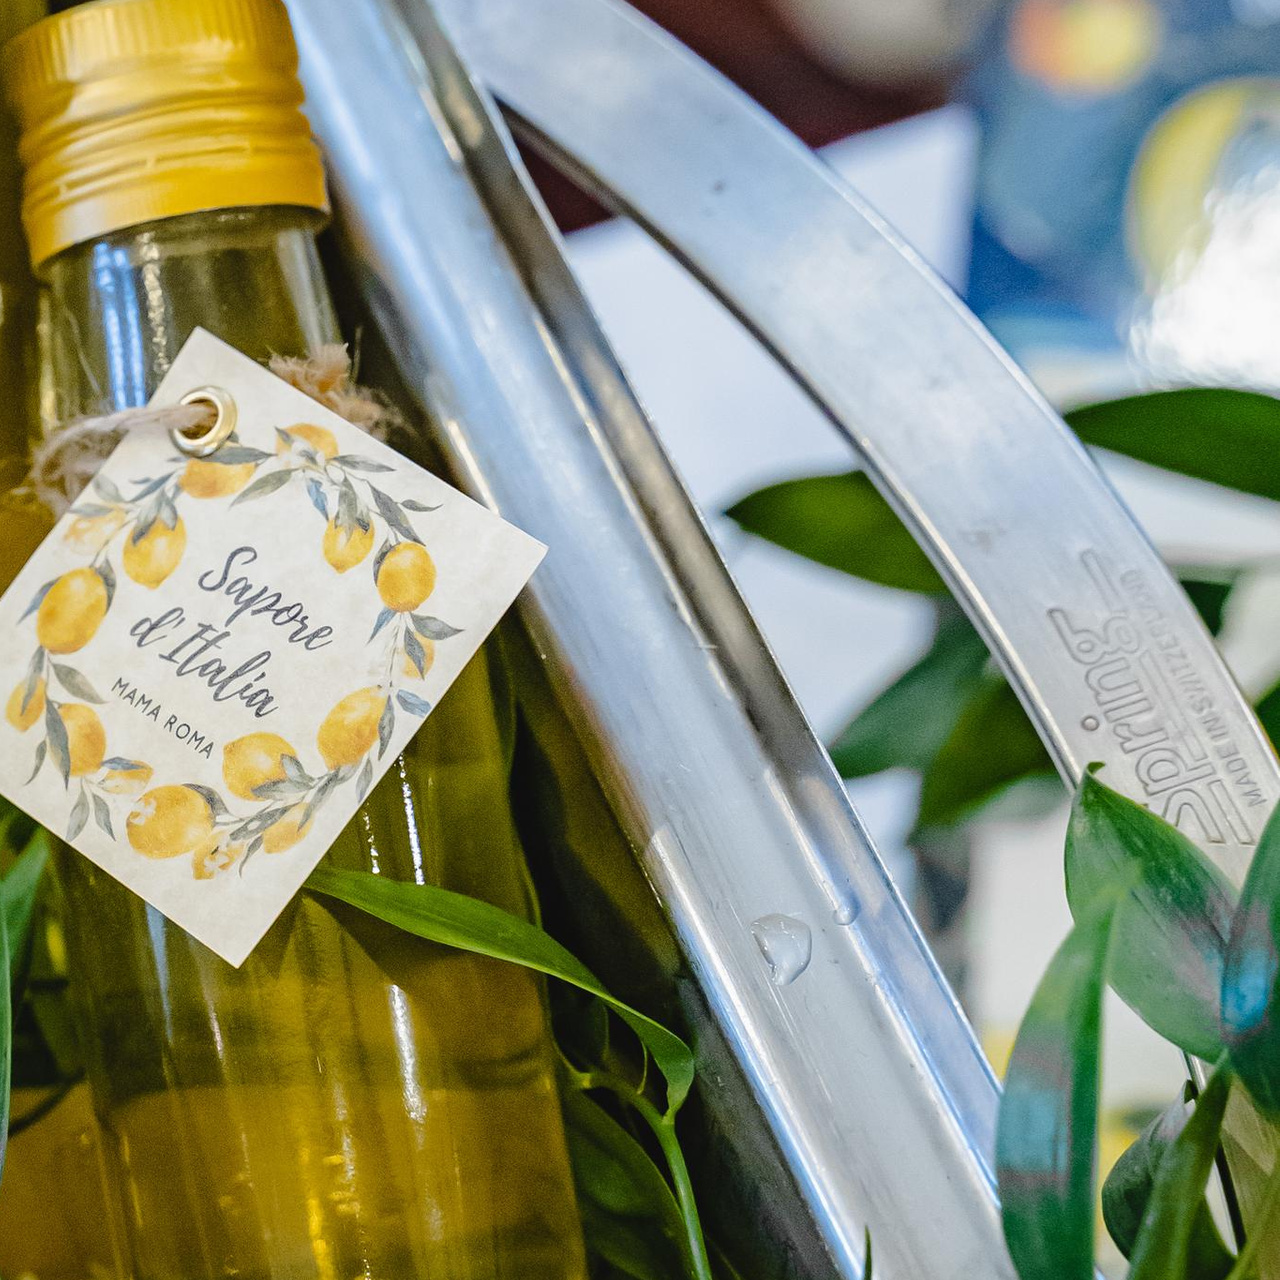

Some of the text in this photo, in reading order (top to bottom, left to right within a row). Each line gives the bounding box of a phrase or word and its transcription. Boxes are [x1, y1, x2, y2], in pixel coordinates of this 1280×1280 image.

[198, 546, 333, 650] Sapore
[130, 606, 279, 718] d'Italia
[111, 677, 215, 759] MAMA ROMA
[1203, 717, 1228, 742] IN
[1225, 747, 1267, 807] MADE
